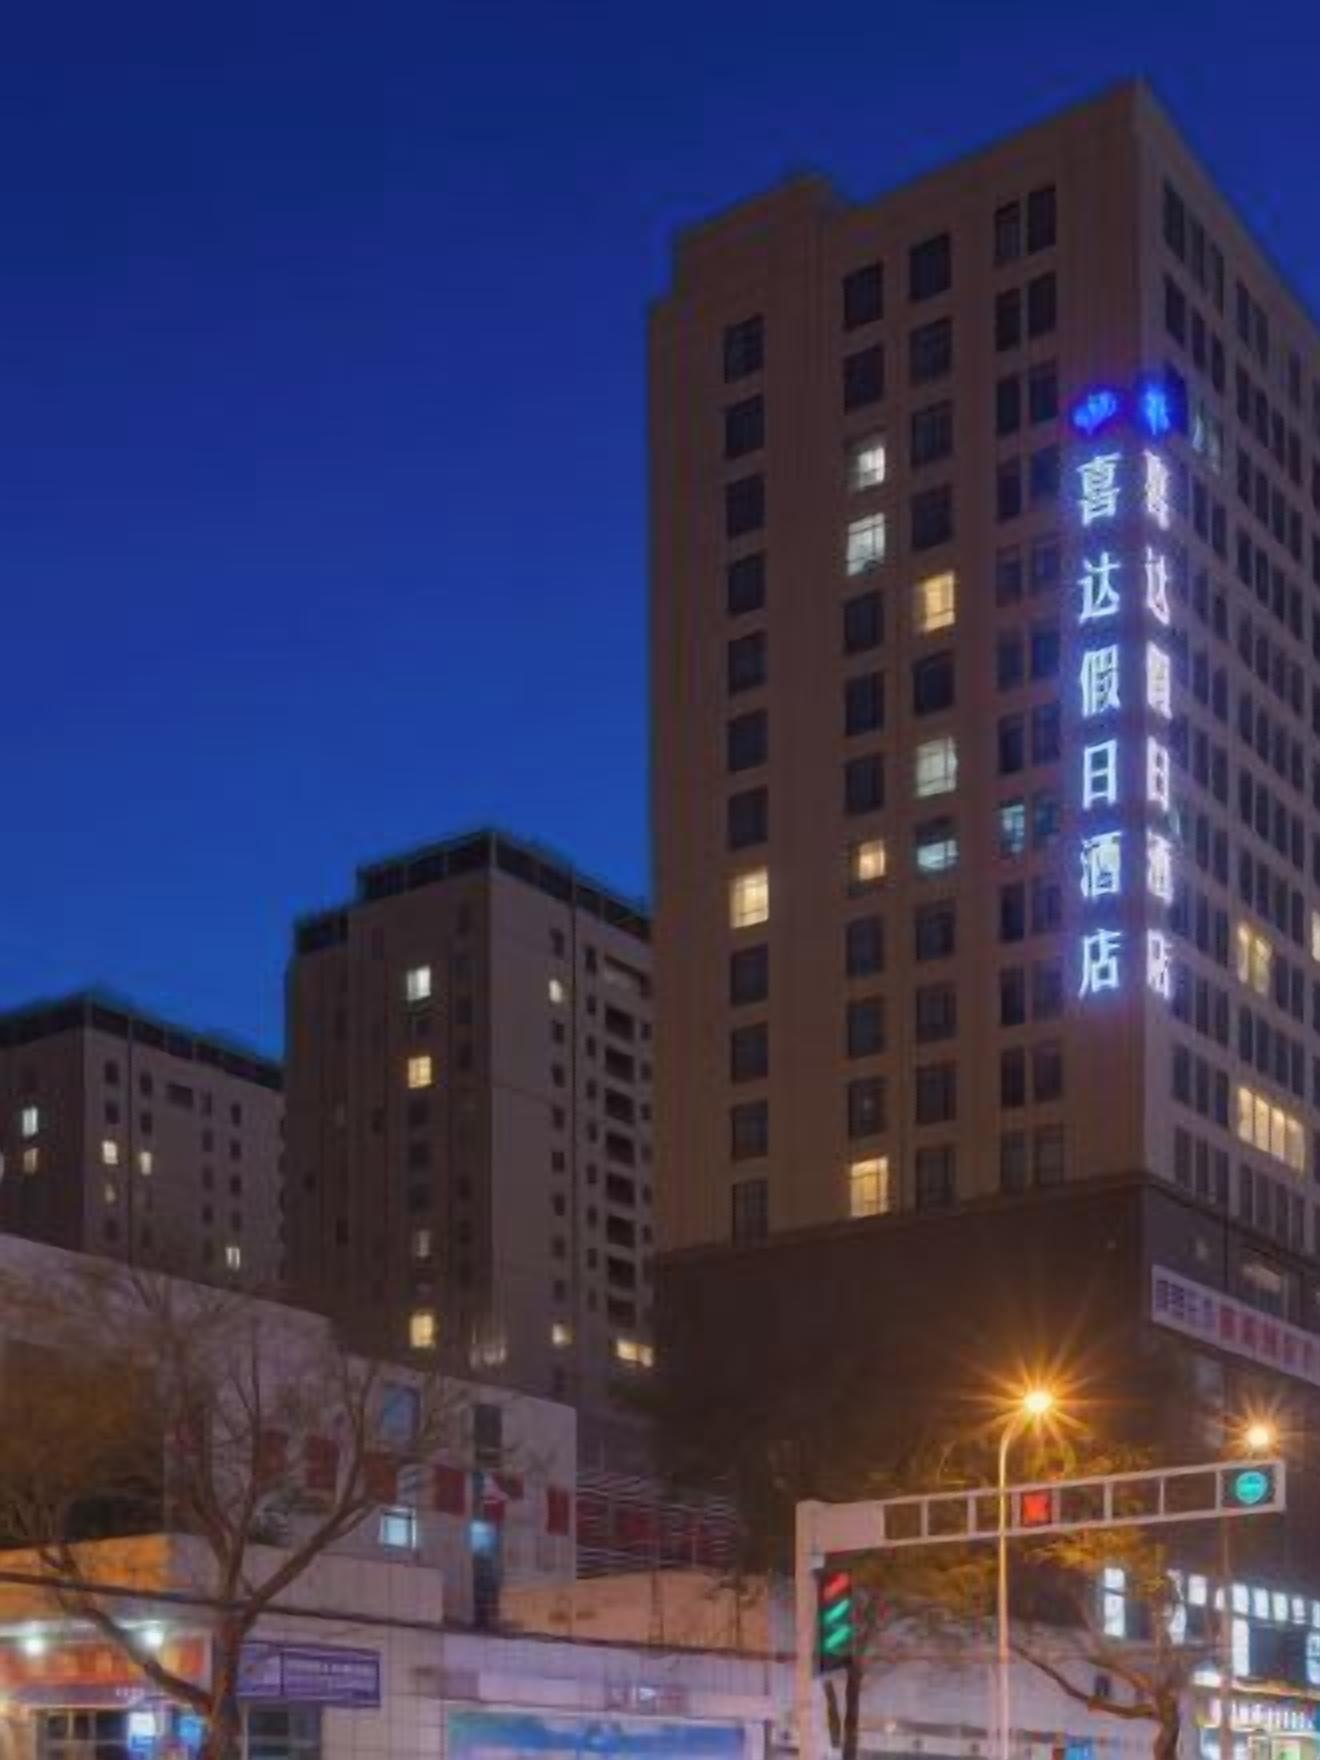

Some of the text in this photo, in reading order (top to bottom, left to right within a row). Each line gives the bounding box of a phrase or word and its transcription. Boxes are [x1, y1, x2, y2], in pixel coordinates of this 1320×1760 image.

[1075, 452, 1122, 1000] 喜达假日酒店
